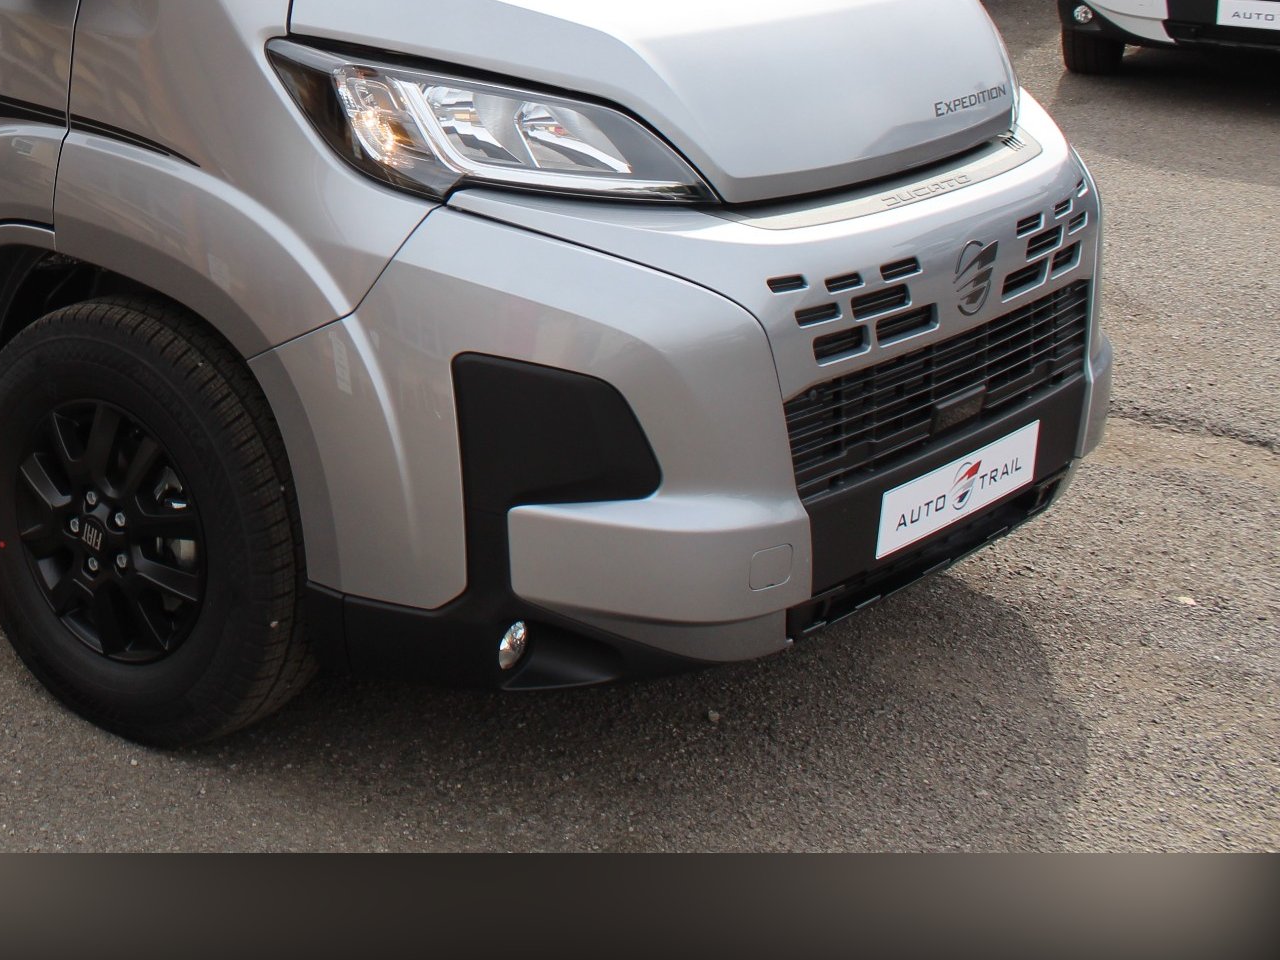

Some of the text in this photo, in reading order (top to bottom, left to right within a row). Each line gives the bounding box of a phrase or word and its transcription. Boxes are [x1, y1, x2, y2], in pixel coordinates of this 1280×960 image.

[1231, 11, 1275, 22] AUTO
[934, 83, 1007, 118] EXPEDITION
[880, 174, 972, 207] DUCATO
[895, 457, 1023, 532] AUTO TRAIL
[81, 523, 102, 551] FIAT
